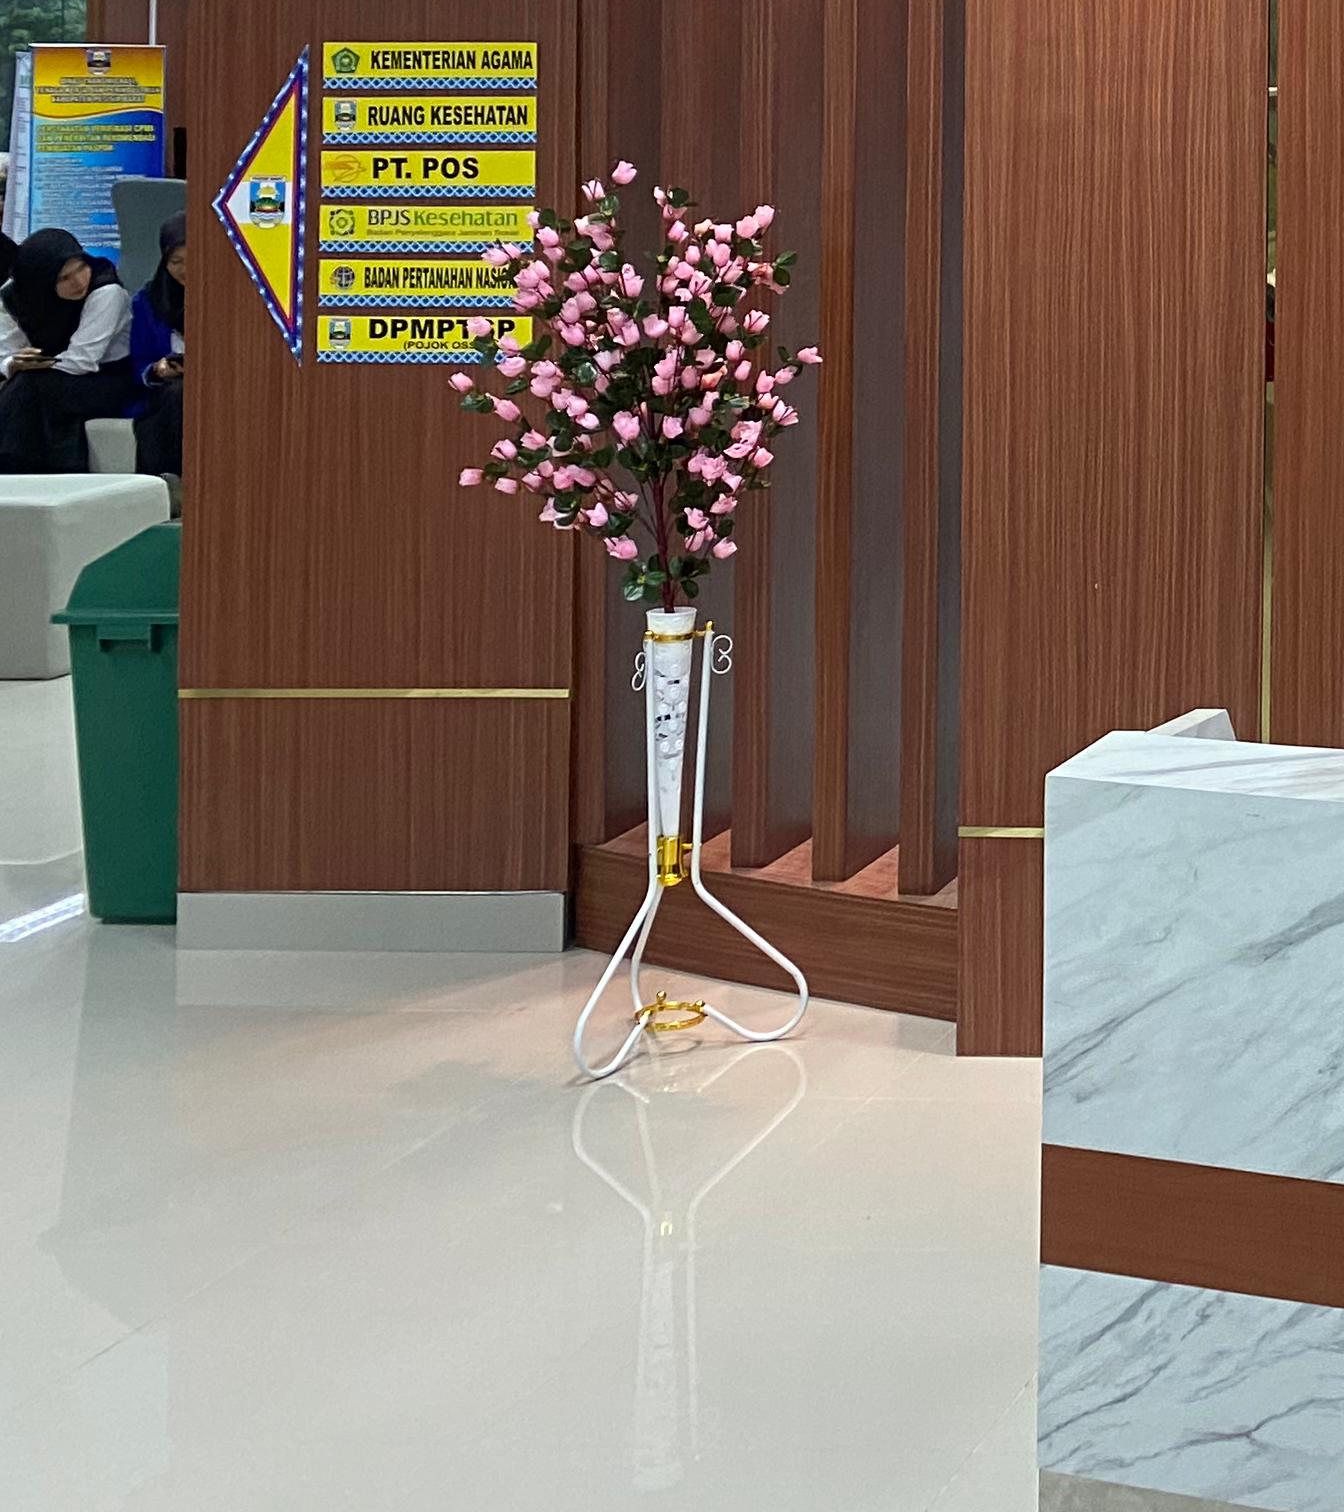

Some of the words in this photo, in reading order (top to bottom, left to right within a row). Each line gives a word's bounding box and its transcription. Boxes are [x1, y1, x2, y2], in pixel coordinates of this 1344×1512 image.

[371, 51, 475, 69] KEMENTERIAN
[481, 51, 532, 69] AGAMA
[369, 106, 424, 125] RUANG
[431, 106, 527, 125] KESEHATAN
[373, 158, 411, 178] PT.
[423, 158, 478, 178] POS
[368, 209, 411, 226] BPJS
[414, 210, 518, 227] Kesehatan
[365, 267, 399, 288] BADAN
[403, 268, 472, 288] PERTANAHAN
[368, 318, 516, 339] DPMPTP
[403, 341, 448, 350] (POJOK
